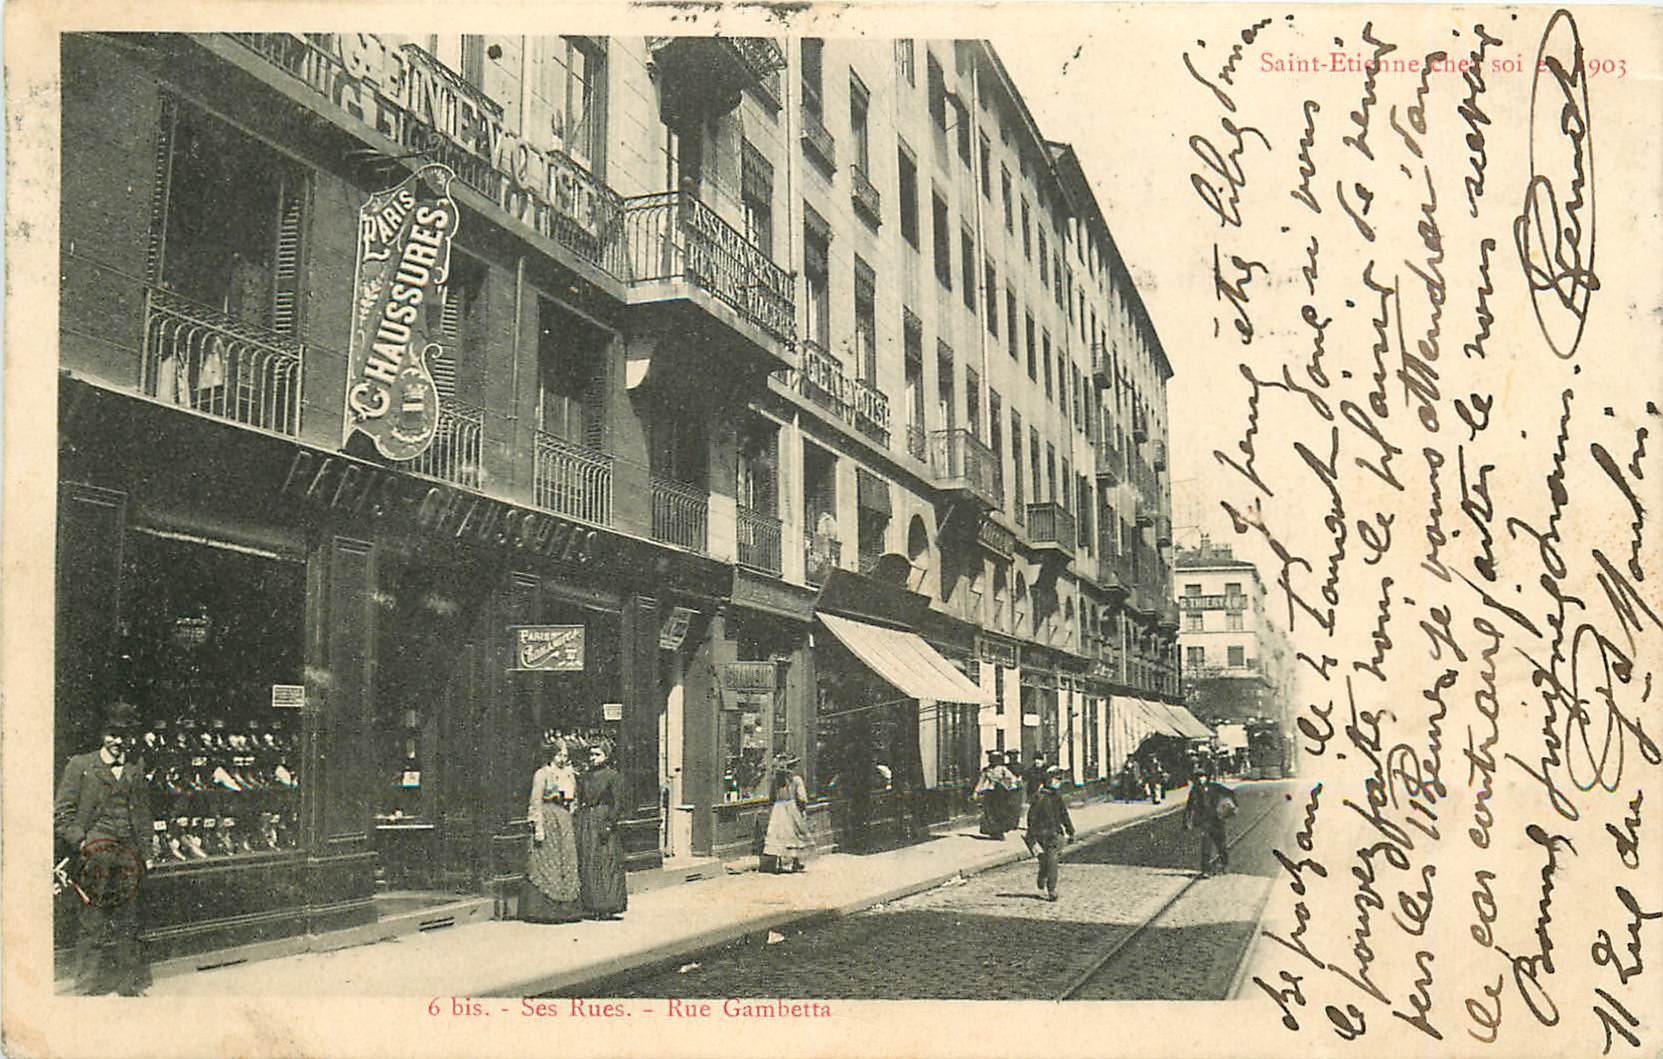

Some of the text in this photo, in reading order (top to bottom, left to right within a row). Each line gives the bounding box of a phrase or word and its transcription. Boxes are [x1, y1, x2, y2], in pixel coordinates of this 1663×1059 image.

[1290, 99, 1321, 214] vous
[362, 190, 416, 262] PARIS
[349, 206, 449, 422] CHAUSSURES
